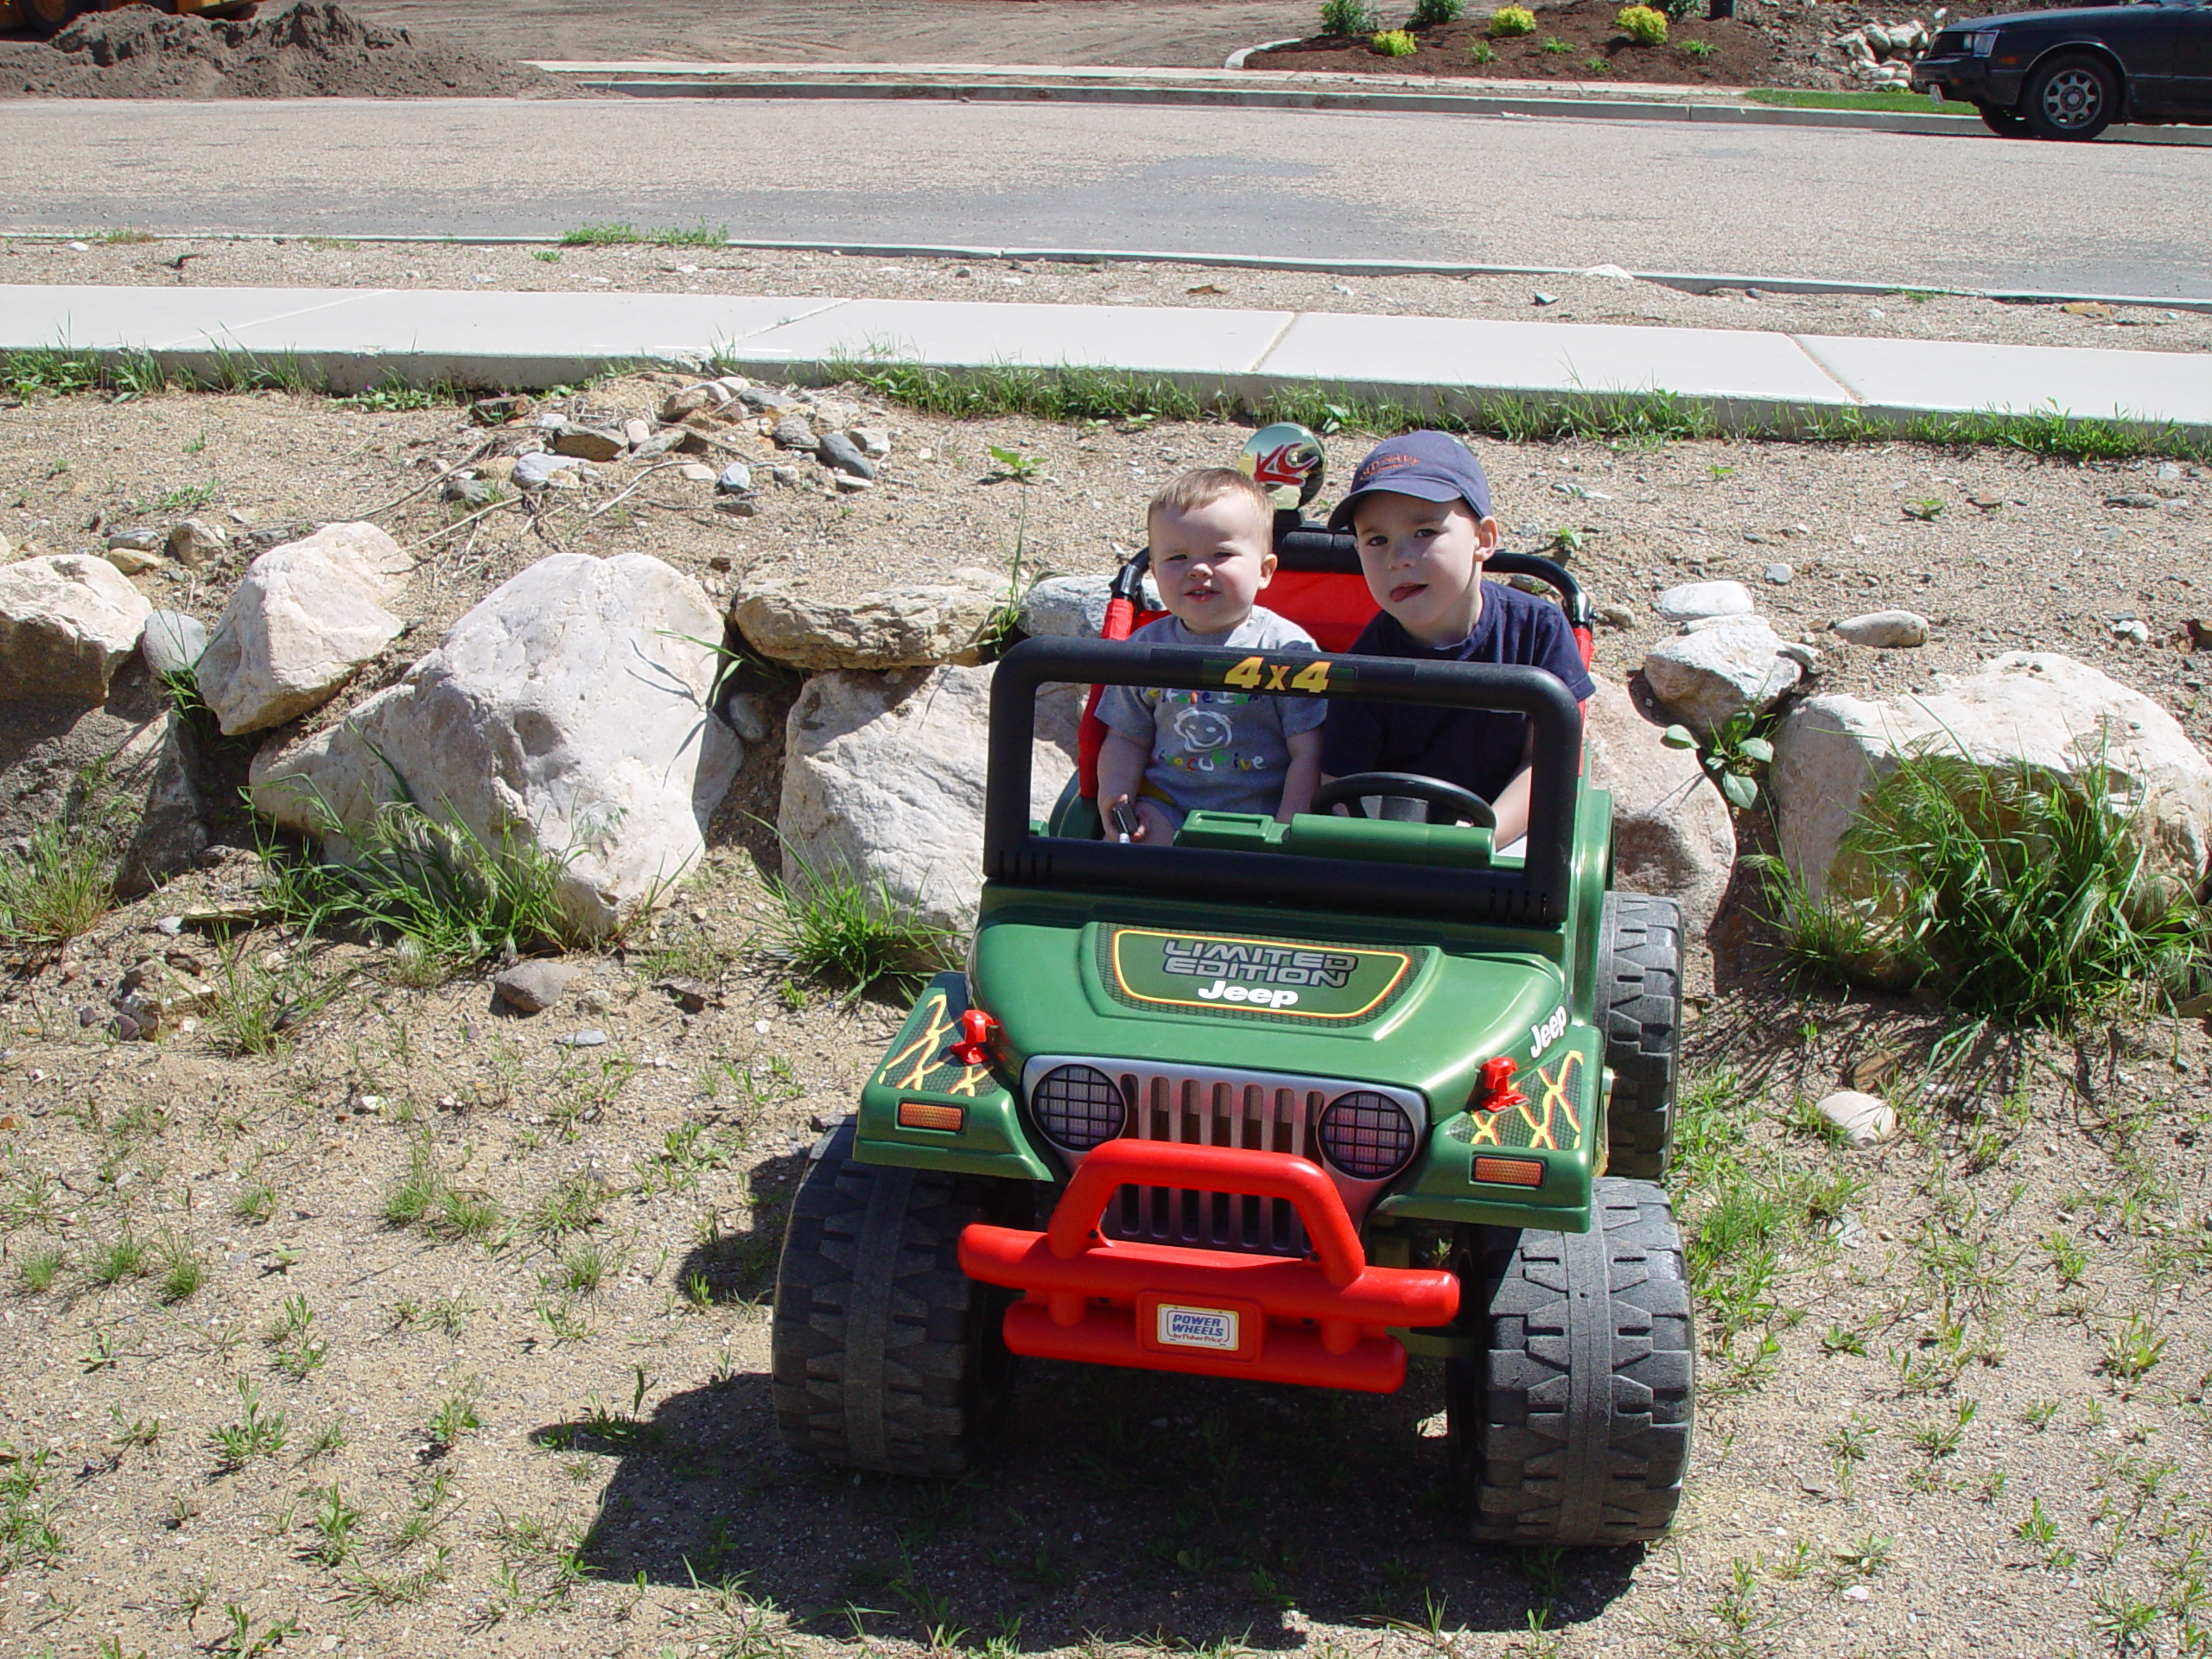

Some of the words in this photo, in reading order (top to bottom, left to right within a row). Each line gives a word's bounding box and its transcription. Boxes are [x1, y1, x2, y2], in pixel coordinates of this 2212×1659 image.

[1254, 441, 1319, 487] KC
[1382, 454, 1421, 466] NAVY
[1165, 939, 1357, 971] LIMITED
[1165, 957, 1347, 987] EDITION
[1198, 980, 1299, 1008] Jeep
[1530, 1005, 1567, 1058] Jeep
[1172, 1324, 1224, 1337] WHEELS
[1173, 1314, 1221, 1327] POWER
